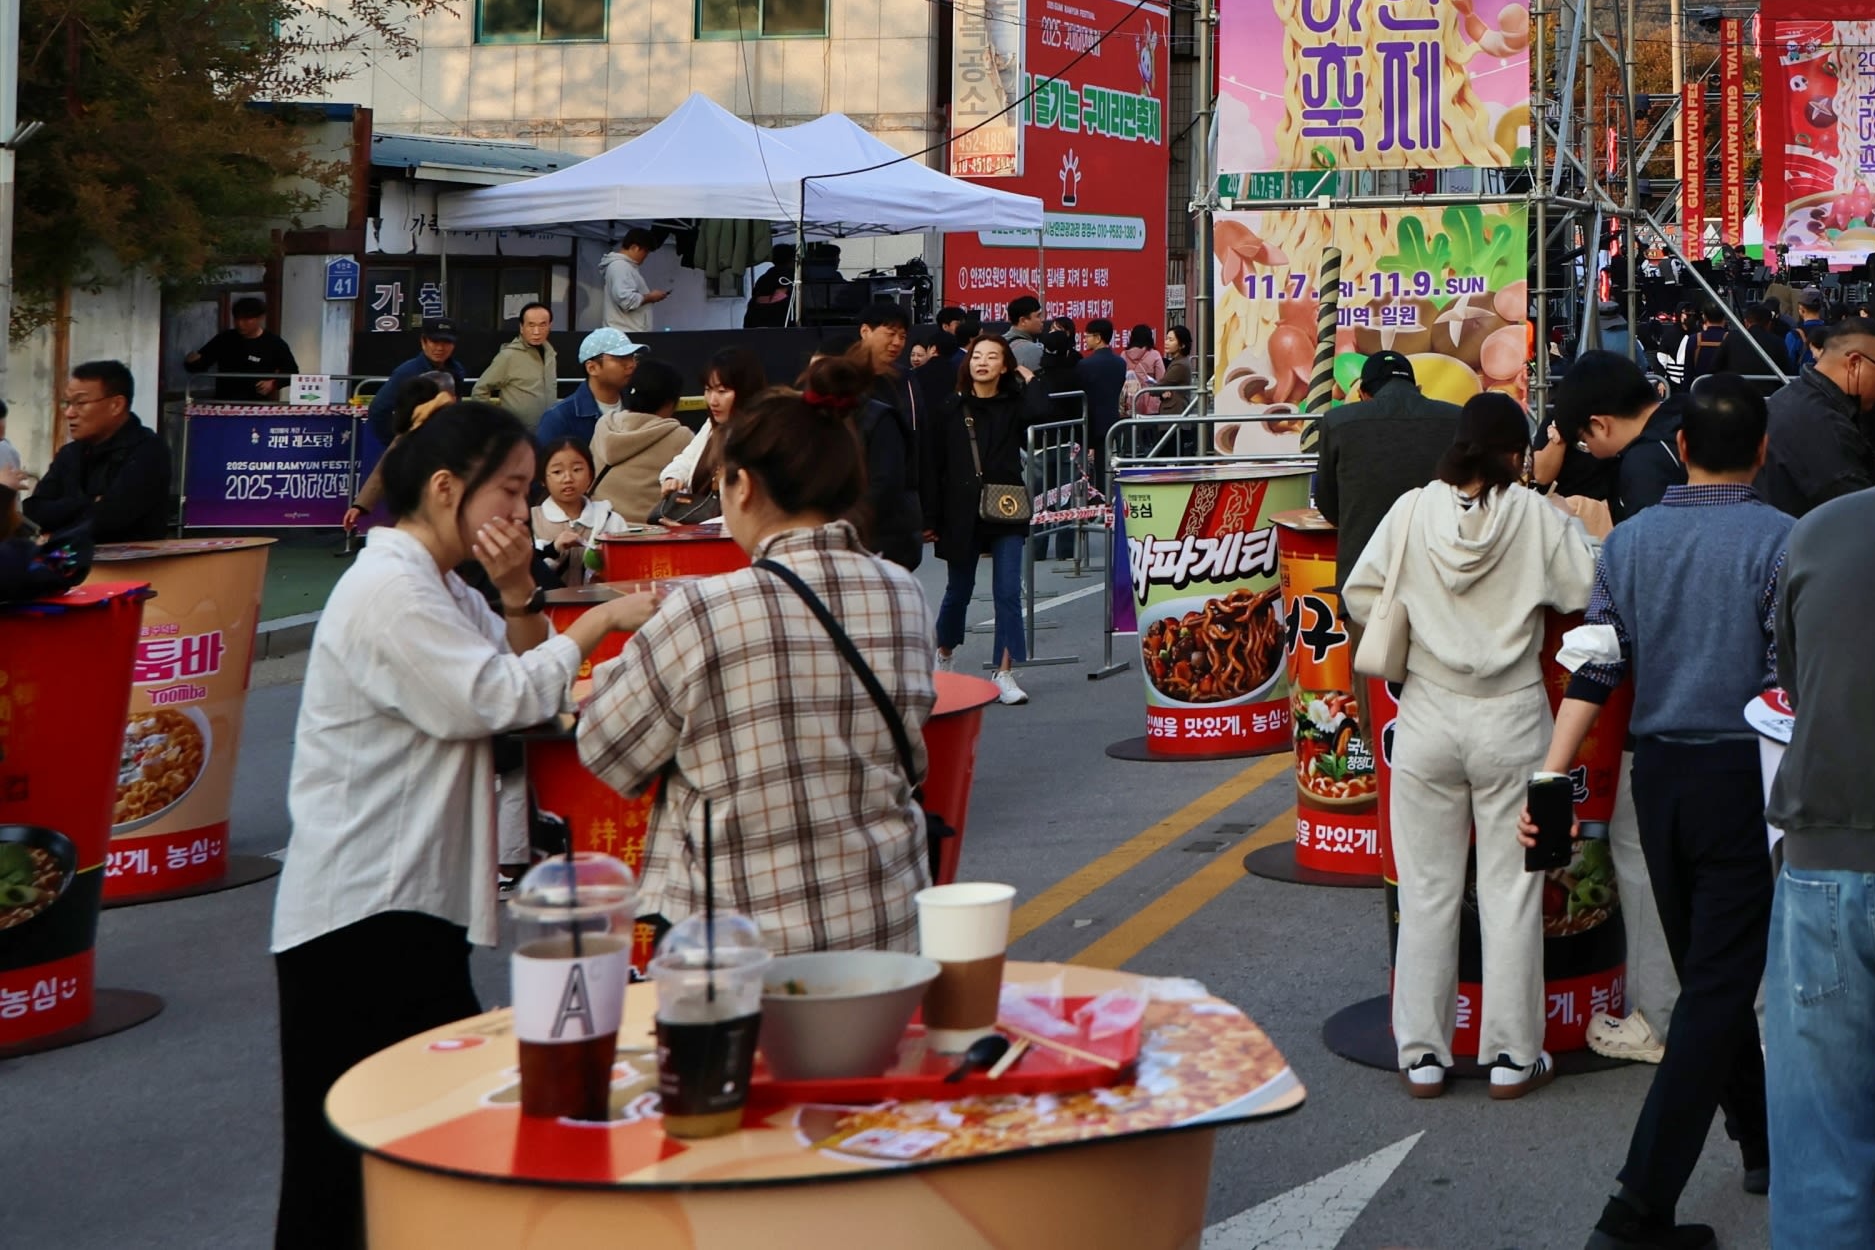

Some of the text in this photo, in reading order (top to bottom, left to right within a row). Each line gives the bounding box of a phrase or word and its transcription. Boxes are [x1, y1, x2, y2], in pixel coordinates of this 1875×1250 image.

[1041, 15, 1062, 49] 2025
[1034, 73, 1162, 146] 즐기는 구미라면축제
[1302, 40, 1442, 153] 축제
[1726, 84, 1738, 122] GUMI
[1687, 109, 1699, 173] RAMYUN
[1726, 122, 1739, 185] RAMYUN
[1687, 173, 1699, 209] GUMI
[333, 277, 353, 295] 41
[970, 267, 1007, 289] 안전요원의
[1047, 268, 1065, 288] 질서를
[1244, 273, 1320, 300] 11.7.
[1369, 270, 1441, 299] 11.9.
[1445, 276, 1485, 295] SUN
[1336, 305, 1417, 328] 미역 일원
[267, 434, 334, 449] 라면 레스토랑
[226, 461, 248, 472] 2025
[248, 461, 276, 472] GUMI
[276, 460, 320, 471] RAMYUN
[225, 472, 362, 501] 2025 구미라면축
[1129, 501, 1153, 519] 농심
[147, 684, 207, 707] Toomba
[1184, 714, 1248, 738] 맛있게,
[1252, 708, 1282, 734] 농심
[103, 837, 209, 877] 있게, 농심
[0, 976, 58, 1019] 농심
[1547, 991, 1583, 1027] 게,
